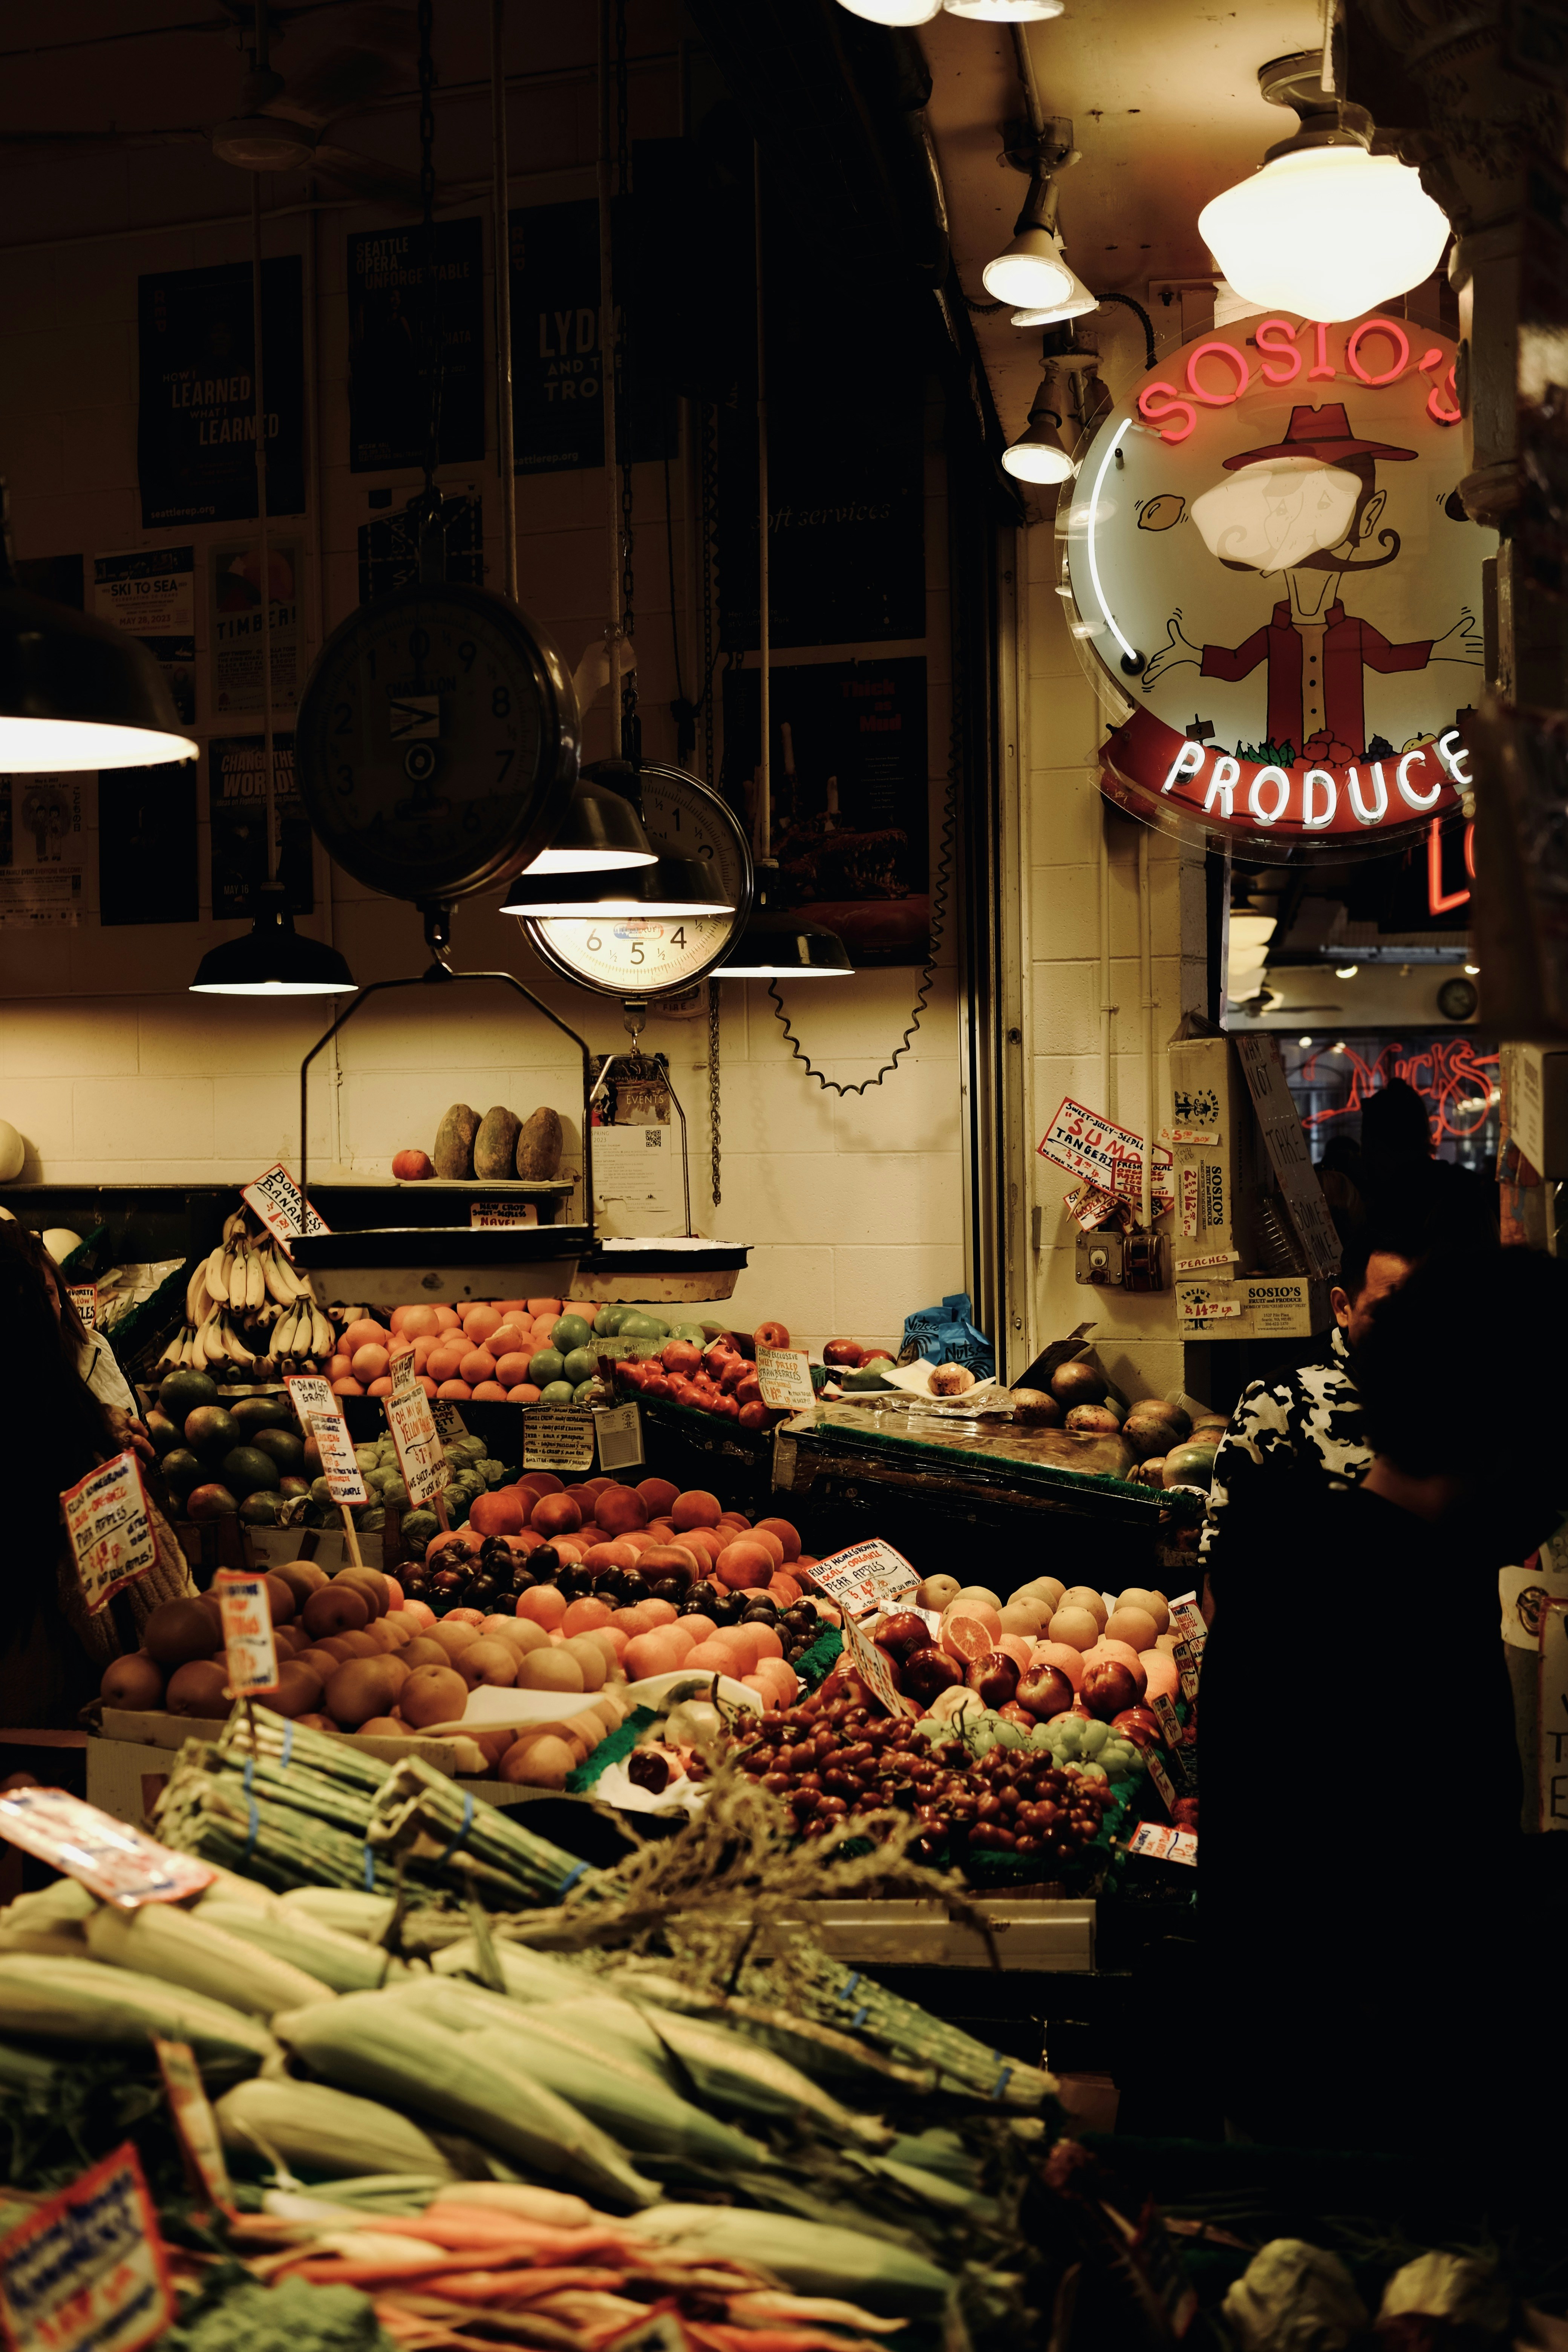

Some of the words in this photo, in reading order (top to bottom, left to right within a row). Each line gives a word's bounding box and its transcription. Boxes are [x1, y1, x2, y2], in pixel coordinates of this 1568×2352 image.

[356, 236, 409, 259] SEATTLE
[154, 289, 166, 332] REP
[163, 371, 189, 382] HOW
[193, 370, 196, 380] I
[548, 360, 583, 376] AND
[172, 375, 251, 408] LEARNED
[190, 407, 220, 419] WHAT
[224, 407, 227, 416] I
[151, 506, 215, 519] seattlerep.org
[798, 501, 891, 527] services
[111, 583, 131, 596] SKI
[134, 582, 151, 594] TO
[154, 579, 178, 593] SEA
[138, 616, 150, 625] 28,
[151, 614, 171, 623] 2023
[458, 640, 477, 674] 9
[840, 678, 896, 698] Thick
[492, 686, 511, 718] 8
[874, 701, 892, 711] as
[334, 702, 353, 735] 2
[860, 713, 902, 732] Mud
[271, 750, 295, 768] THE
[495, 750, 515, 782] 7
[223, 769, 297, 798] WORD!
[336, 764, 354, 796] 3
[1164, 729, 1475, 826] PRODUCE
[239, 796, 262, 806] Fighting
[462, 801, 481, 831] 6
[672, 808, 680, 831] 1
[224, 884, 239, 895] MAY
[242, 884, 249, 894] 16
[586, 928, 602, 951] 6
[670, 926, 687, 949] 4
[630, 942, 645, 965] 5
[1248, 1063, 1274, 1101] NOT
[626, 1095, 664, 1104] EVENTS
[1265, 1124, 1306, 1167] TAKE
[1117, 1161, 1142, 1170] FRESH
[1184, 1170, 1197, 1181] 2
[1050, 1153, 1065, 1165] PACK
[1117, 1193, 1131, 1202] SOME
[1184, 1181, 1196, 1189] FOR
[1201, 1196, 1206, 1204] MY
[1211, 1166, 1223, 1225] SOSIO'S
[1292, 1201, 1325, 1233] SOME
[1308, 1231, 1338, 1266] HOME
[1178, 1254, 1228, 1269] PEACHES
[1181, 1288, 1211, 1300] SOSIO'S
[1248, 1286, 1301, 1298] SOSIO'S
[758, 1358, 773, 1367] SWEET
[775, 1361, 798, 1375] DRIED
[772, 1351, 798, 1360] EXCLUSIVE
[758, 1368, 801, 1381] STRAWBERRIES
[421, 1480, 436, 1499] JUST
[95, 1505, 127, 1533] APPLES
[808, 1562, 832, 1577] RICK'S
[831, 1541, 879, 1566] HOMEGROWN
[818, 1568, 844, 1584] LOCAL
[847, 1550, 883, 1567] ORGANIC
[824, 1576, 852, 1593] PEAR
[852, 1561, 885, 1580] APPLES
